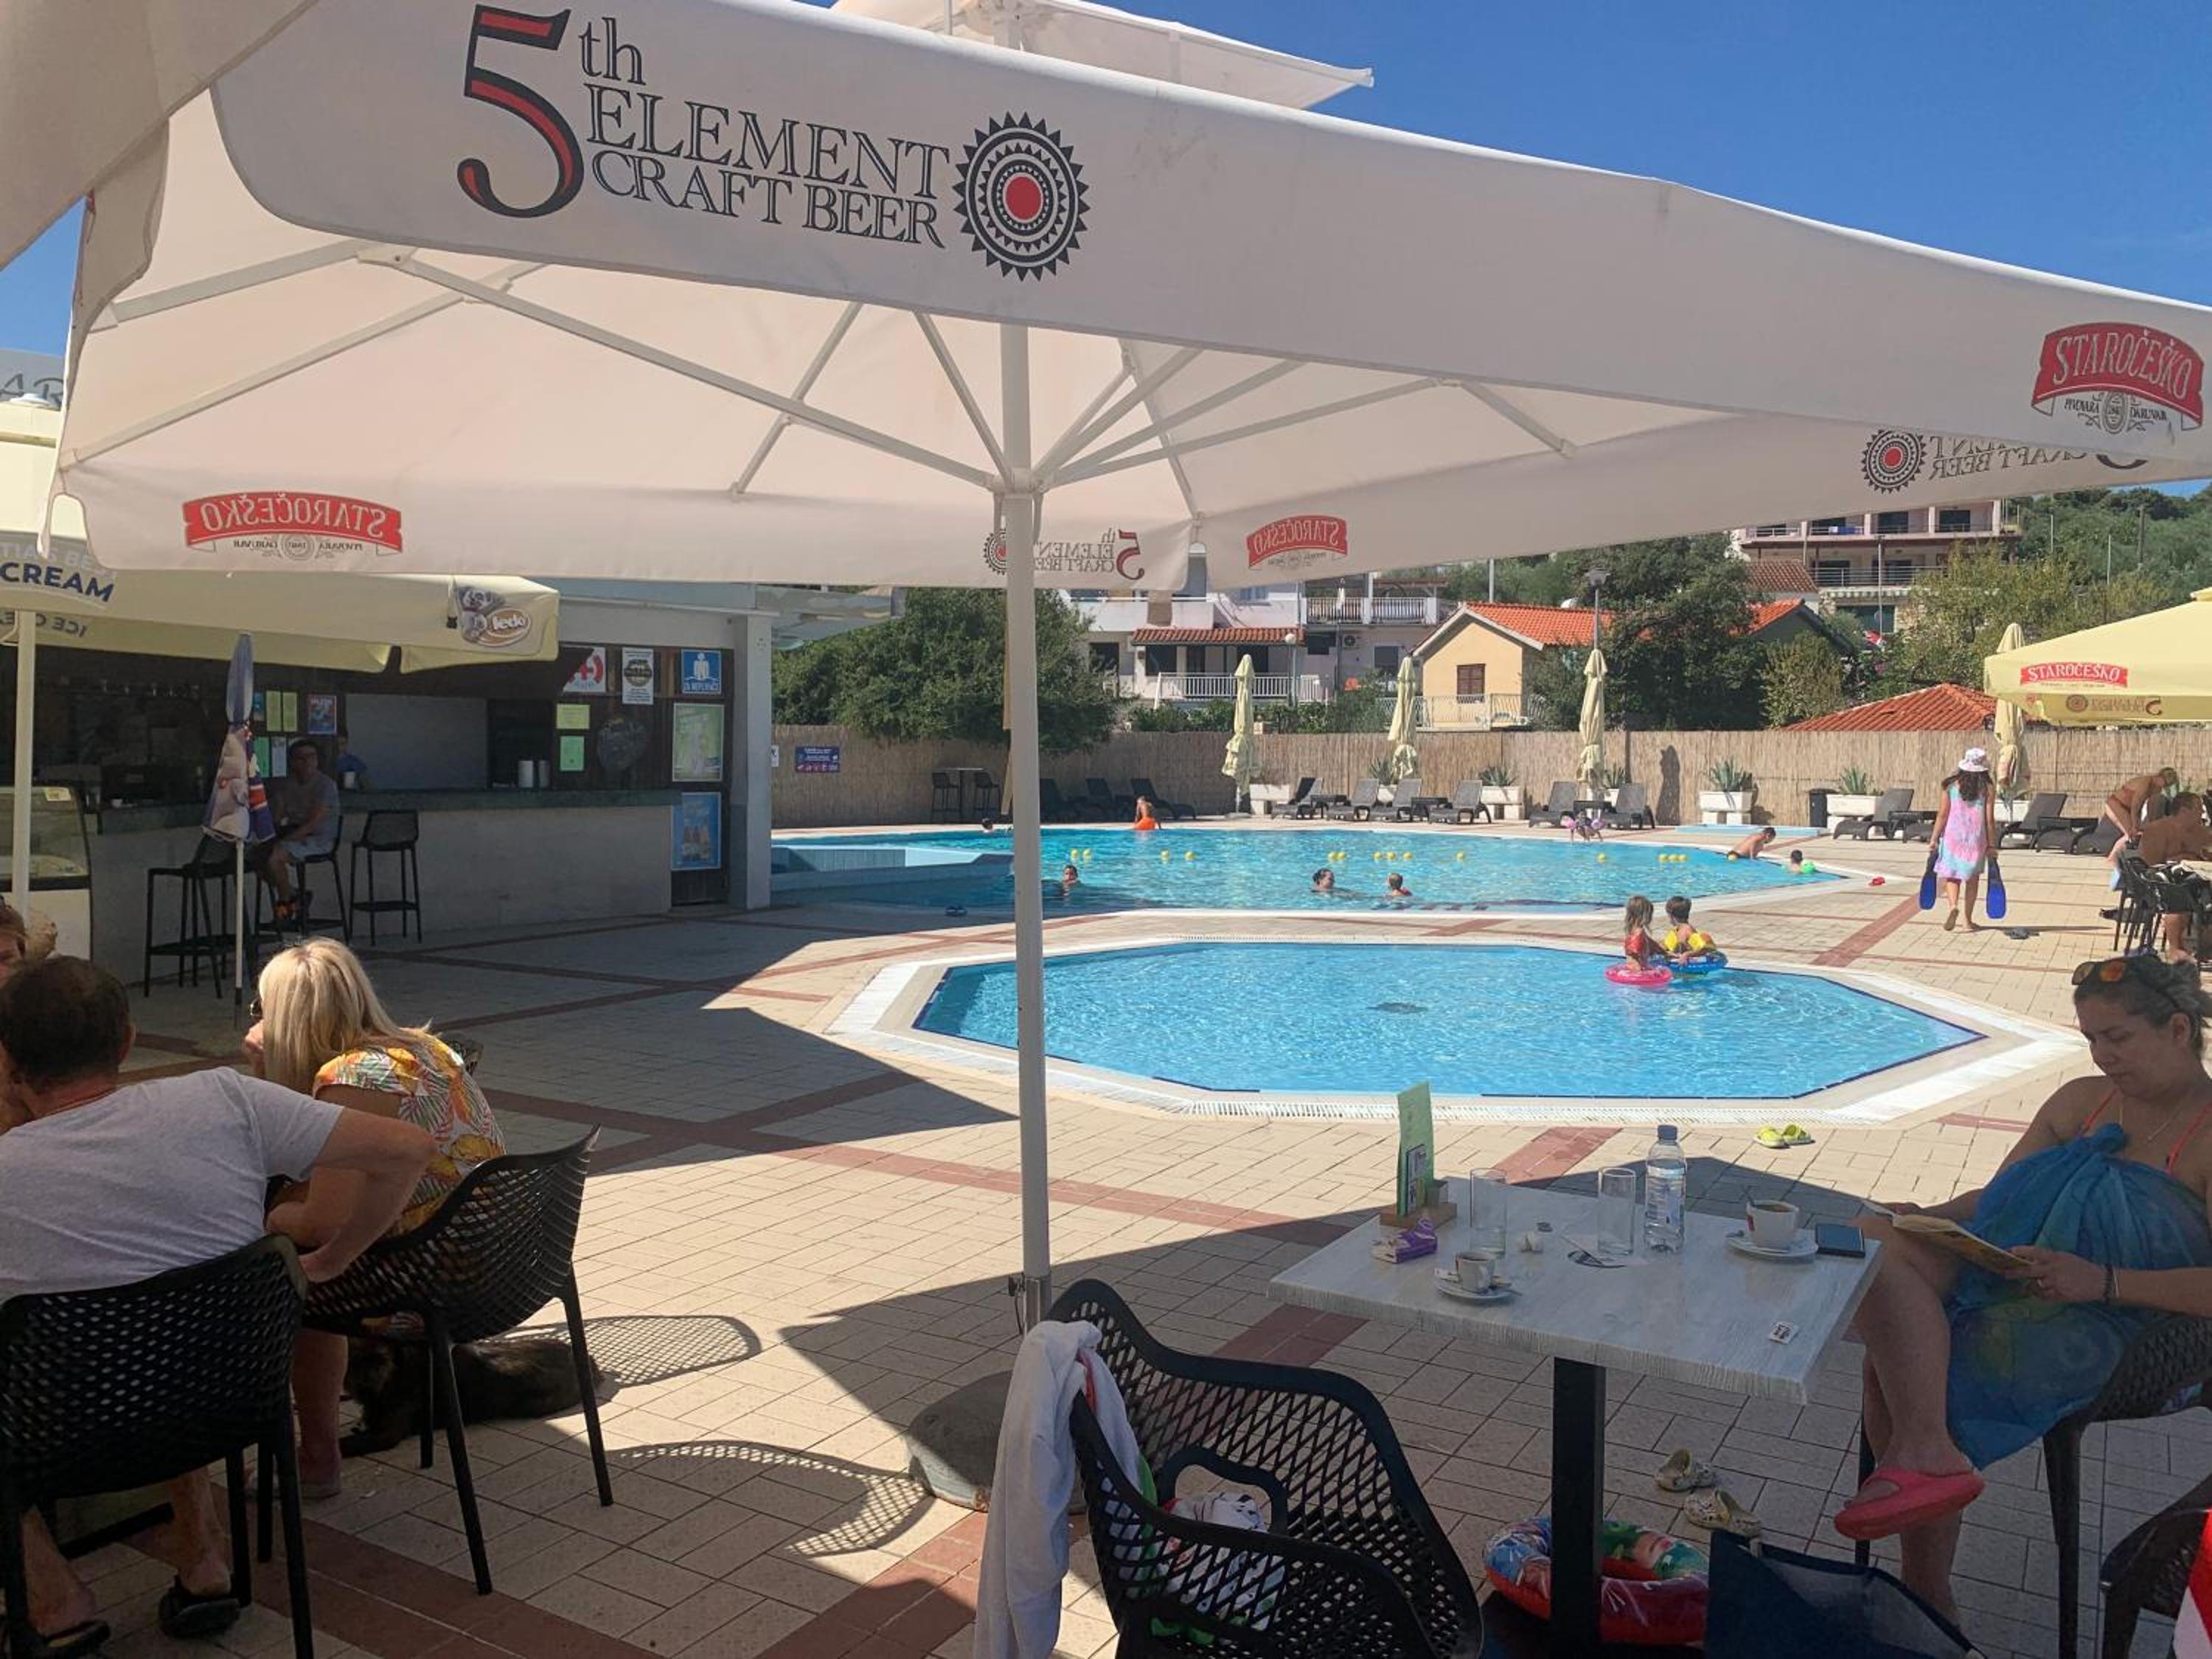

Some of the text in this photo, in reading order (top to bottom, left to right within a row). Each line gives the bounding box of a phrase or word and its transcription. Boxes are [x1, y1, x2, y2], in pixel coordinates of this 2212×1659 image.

[585, 82, 950, 201] ELEMENT
[591, 149, 946, 249] CRAFT BEER
[2052, 330, 2192, 400] STAROČEŠKO
[0, 562, 115, 602] CREAM
